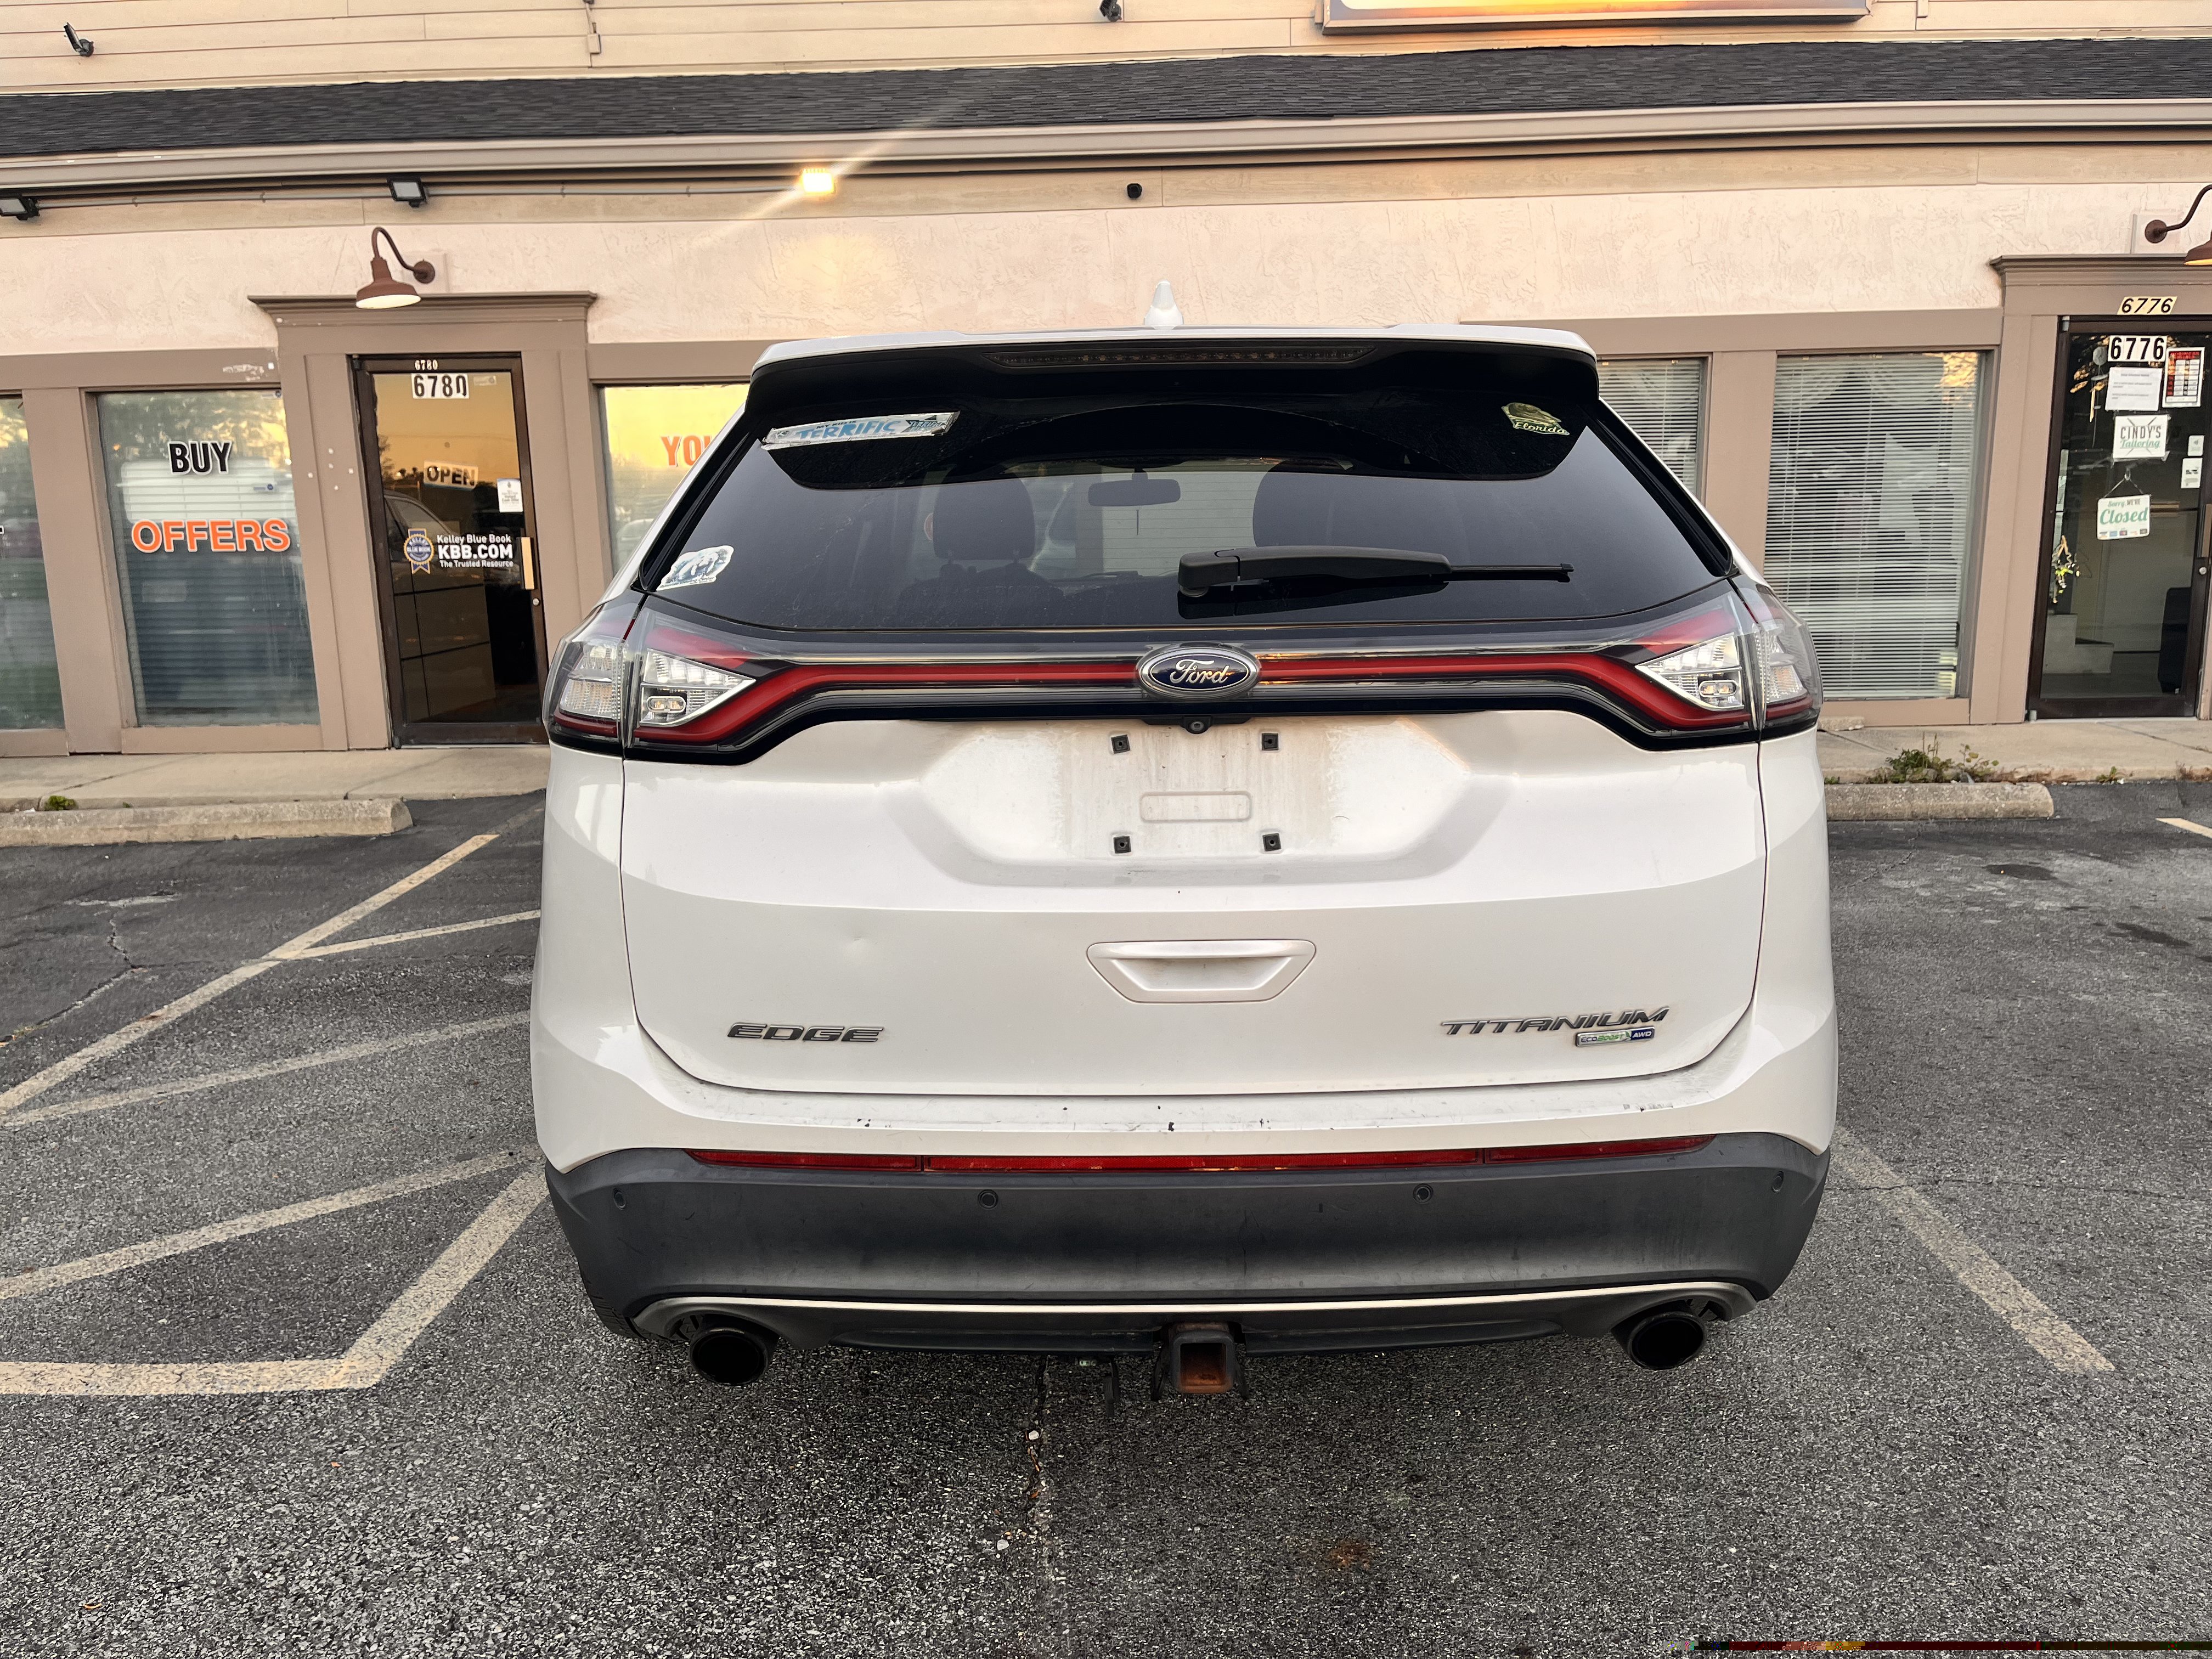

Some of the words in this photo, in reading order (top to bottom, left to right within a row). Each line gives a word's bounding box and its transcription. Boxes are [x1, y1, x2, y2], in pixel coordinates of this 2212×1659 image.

[2121, 298, 2173, 314] 6776
[2111, 337, 2164, 360] 6776
[415, 359, 438, 370] 6780
[414, 375, 467, 397] 6780
[795, 420, 901, 439] TERRIFIC
[1515, 421, 1567, 434] Florida
[2120, 425, 2162, 439] CINDY'S
[660, 435, 711, 466] YO
[2120, 439, 2160, 449] Tailoring
[168, 441, 232, 475] BUY
[427, 465, 475, 486] OPEN
[2100, 507, 2148, 525] Closed
[132, 518, 291, 553] OFFERS
[437, 534, 465, 545] Kelley
[466, 534, 487, 543] Blue
[489, 534, 511, 543] Book
[438, 544, 514, 560] KBB.COM
[1170, 659, 1230, 684] Ford
[1441, 1005, 1671, 1035] TITANIUM
[727, 1022, 884, 1042] EDGE
